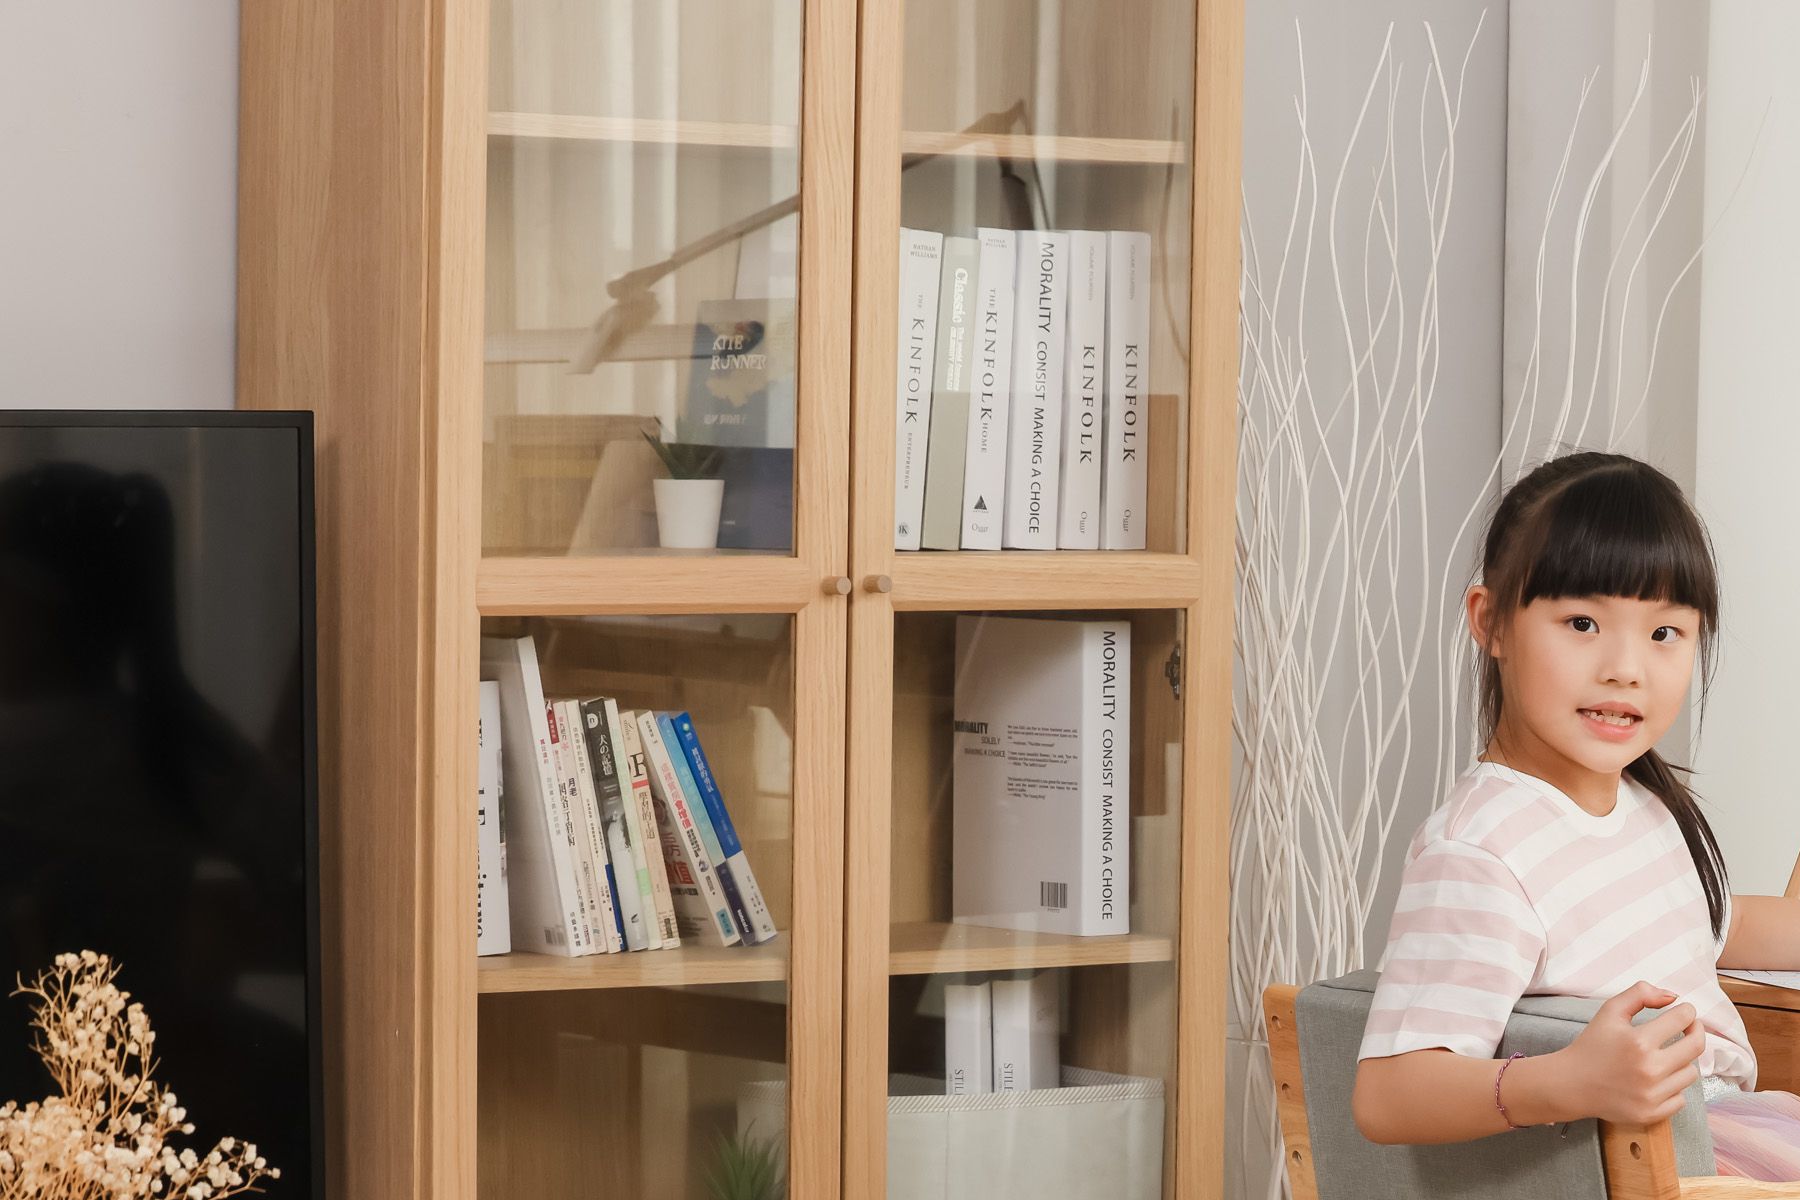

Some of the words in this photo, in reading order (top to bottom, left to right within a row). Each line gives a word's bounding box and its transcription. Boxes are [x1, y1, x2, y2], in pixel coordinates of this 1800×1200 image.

[1038, 242, 1055, 332] MORALITY
[710, 354, 767, 370] RUNNER
[905, 318, 924, 423] KINFOLK
[981, 311, 997, 420] KINFOLK
[1035, 341, 1048, 400] CONSIST
[1080, 345, 1095, 463] KINFOLK
[1123, 344, 1138, 462] KINFOLK
[1032, 408, 1044, 465] MAKING
[1031, 469, 1041, 478] A
[1028, 481, 1041, 534] CHOICE
[1103, 631, 1115, 720] MORALITY
[1102, 729, 1113, 788] CONSIST
[1103, 795, 1113, 851] MAKING
[1103, 856, 1112, 864] A
[1102, 868, 1113, 920] CHOICE
[955, 1069, 964, 1095] STIL
